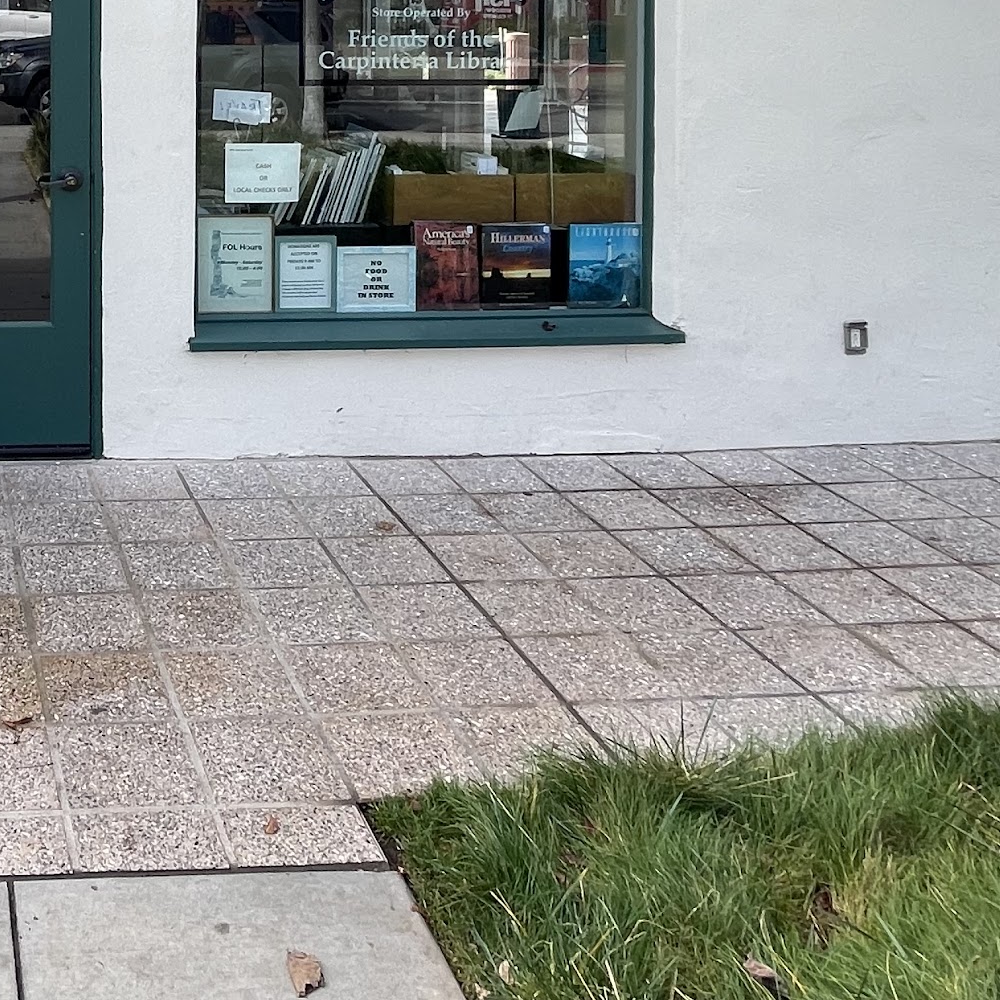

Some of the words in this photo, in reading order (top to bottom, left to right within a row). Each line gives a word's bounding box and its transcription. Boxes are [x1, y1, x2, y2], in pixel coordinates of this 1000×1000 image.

[371, 7, 402, 19] Store
[403, 7, 454, 22] Operated
[456, 7, 472, 22] By
[347, 29, 428, 49] Friends
[433, 28, 456, 49] of
[461, 29, 496, 49] the
[318, 51, 439, 74] Carpinteria
[446, 50, 509, 71] Libra
[490, 232, 546, 244] HILLERMAN
[222, 243, 238, 251] FOL
[239, 243, 263, 251] Hours
